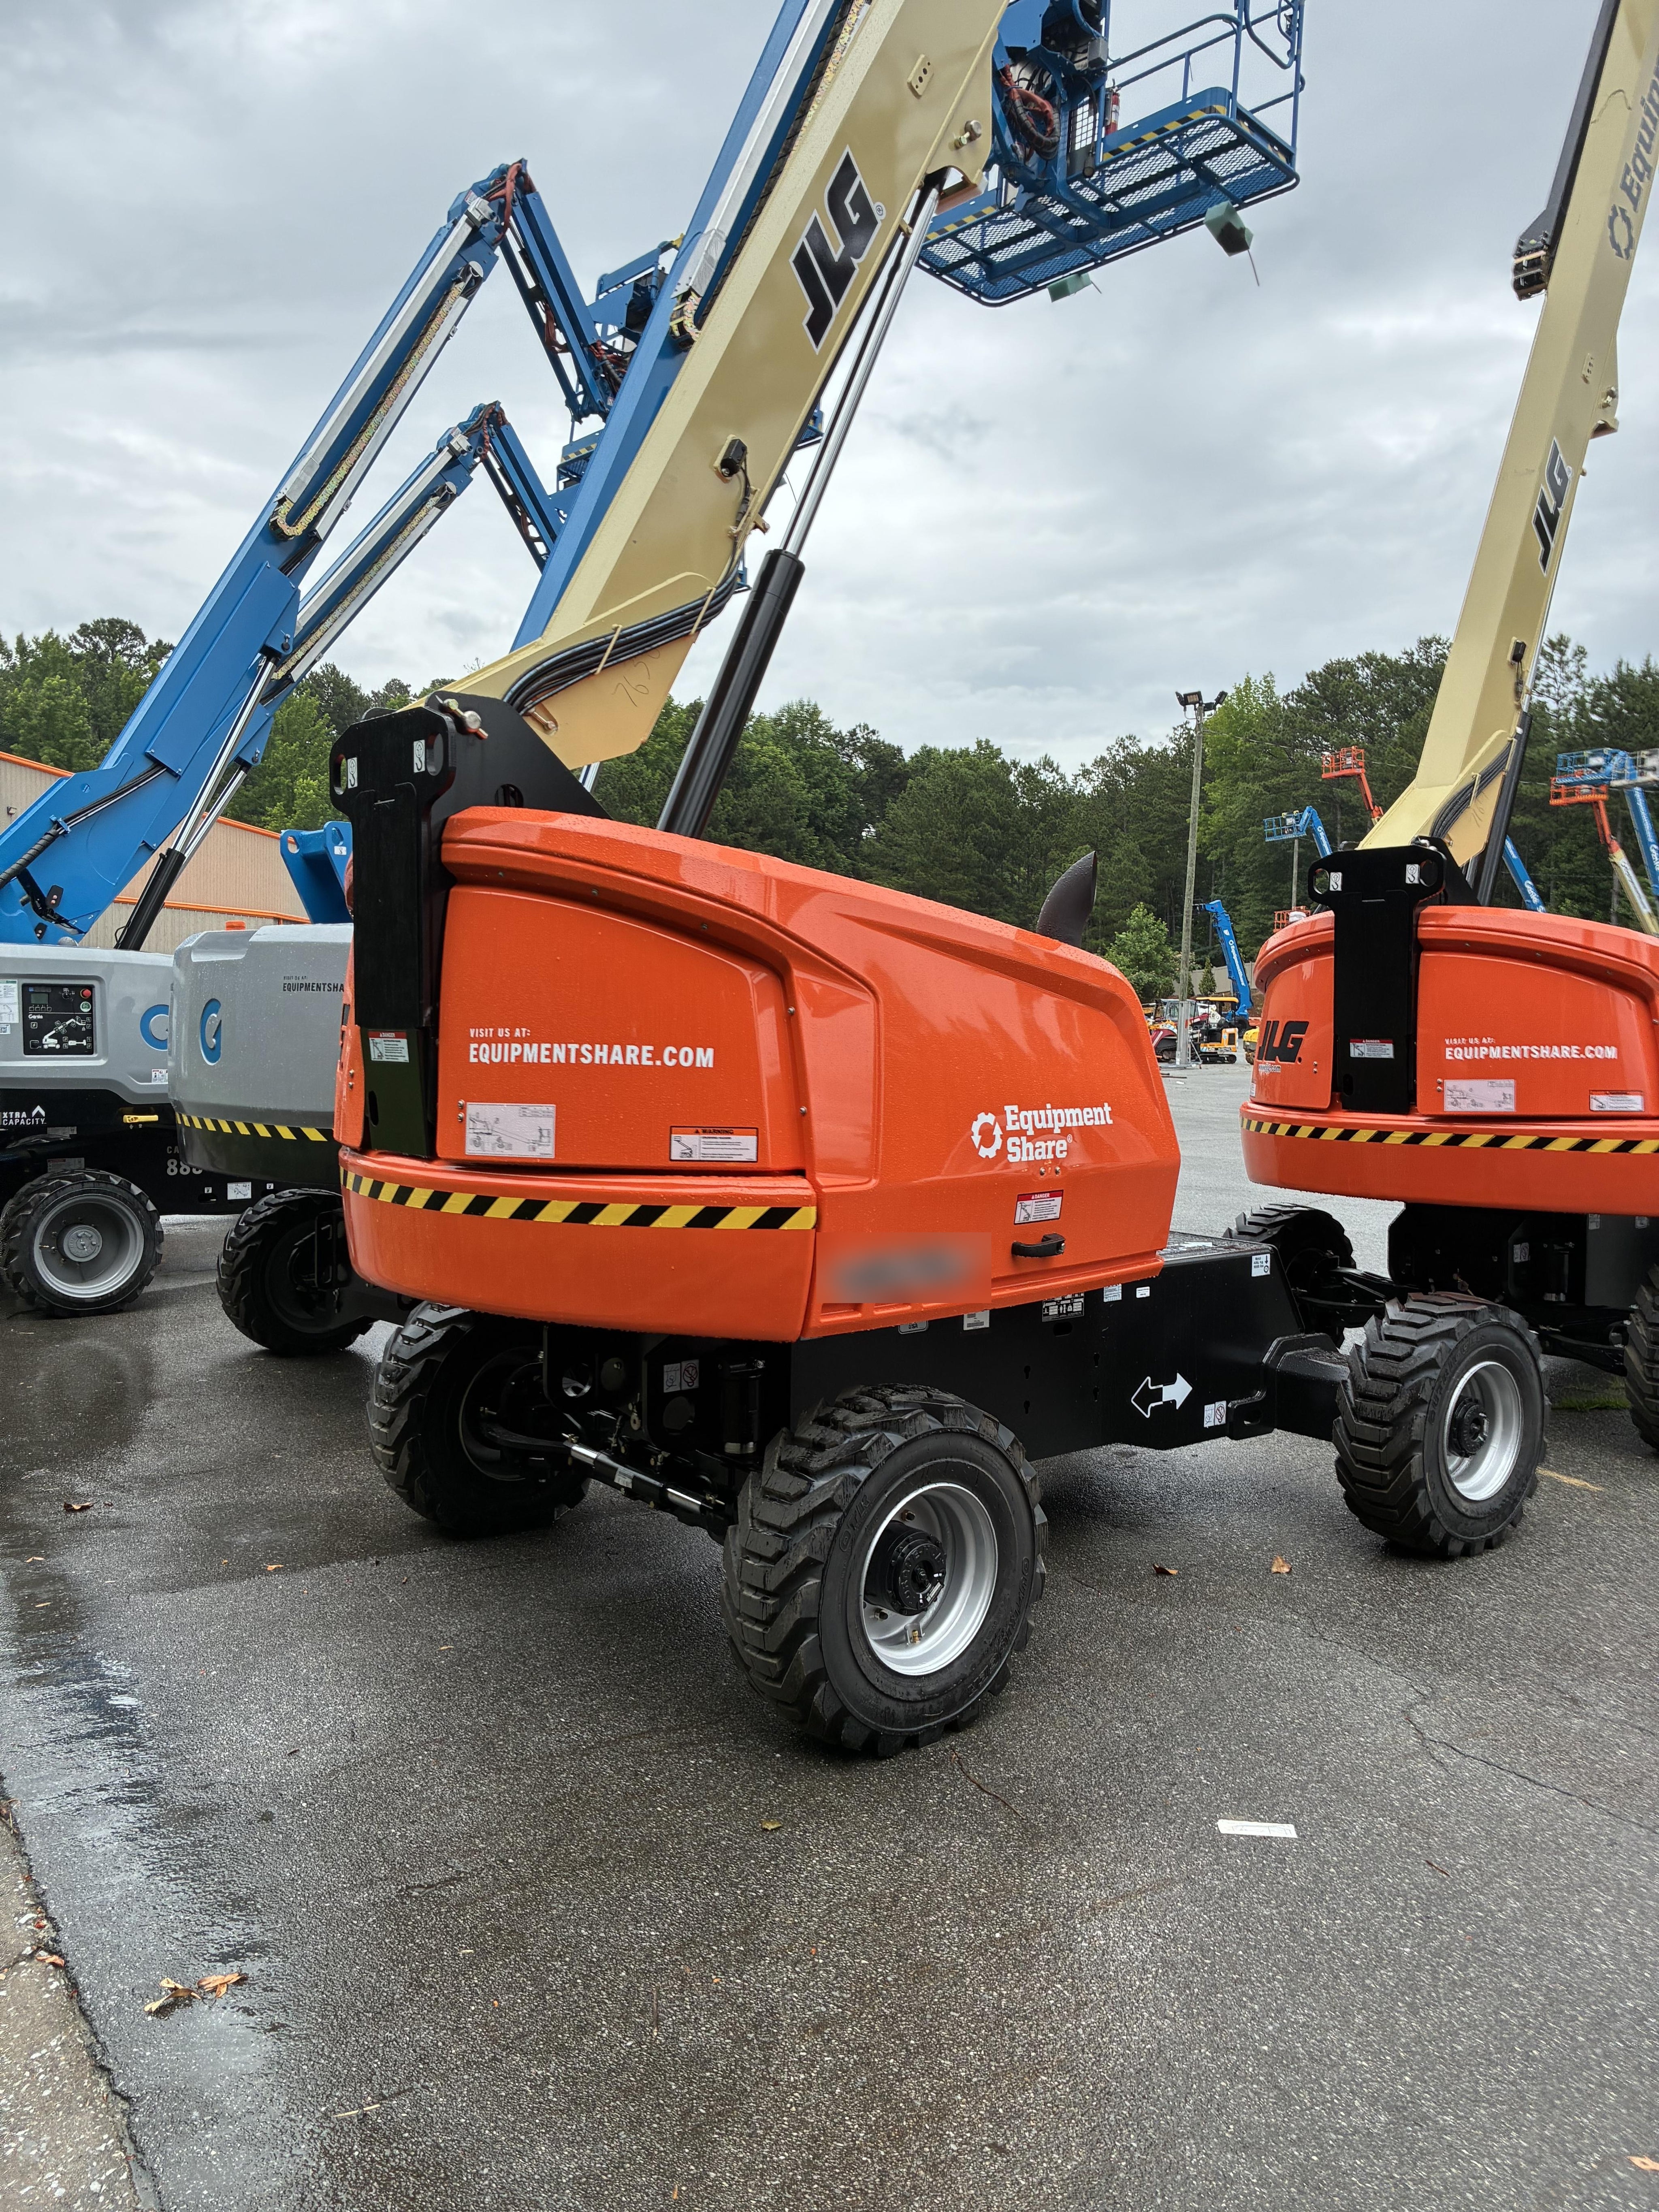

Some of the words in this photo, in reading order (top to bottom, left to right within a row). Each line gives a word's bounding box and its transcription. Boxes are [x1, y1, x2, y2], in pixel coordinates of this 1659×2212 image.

[469, 1028, 494, 1037] VISIT
[498, 1028, 510, 1037] US
[514, 1028, 531, 1037] AT:
[469, 1043, 714, 1068] EQUIPMENTSHARE.COM
[1445, 1045, 1618, 1060] EQUIPMENTSHARE.COM
[1004, 1103, 1113, 1135] Equipment
